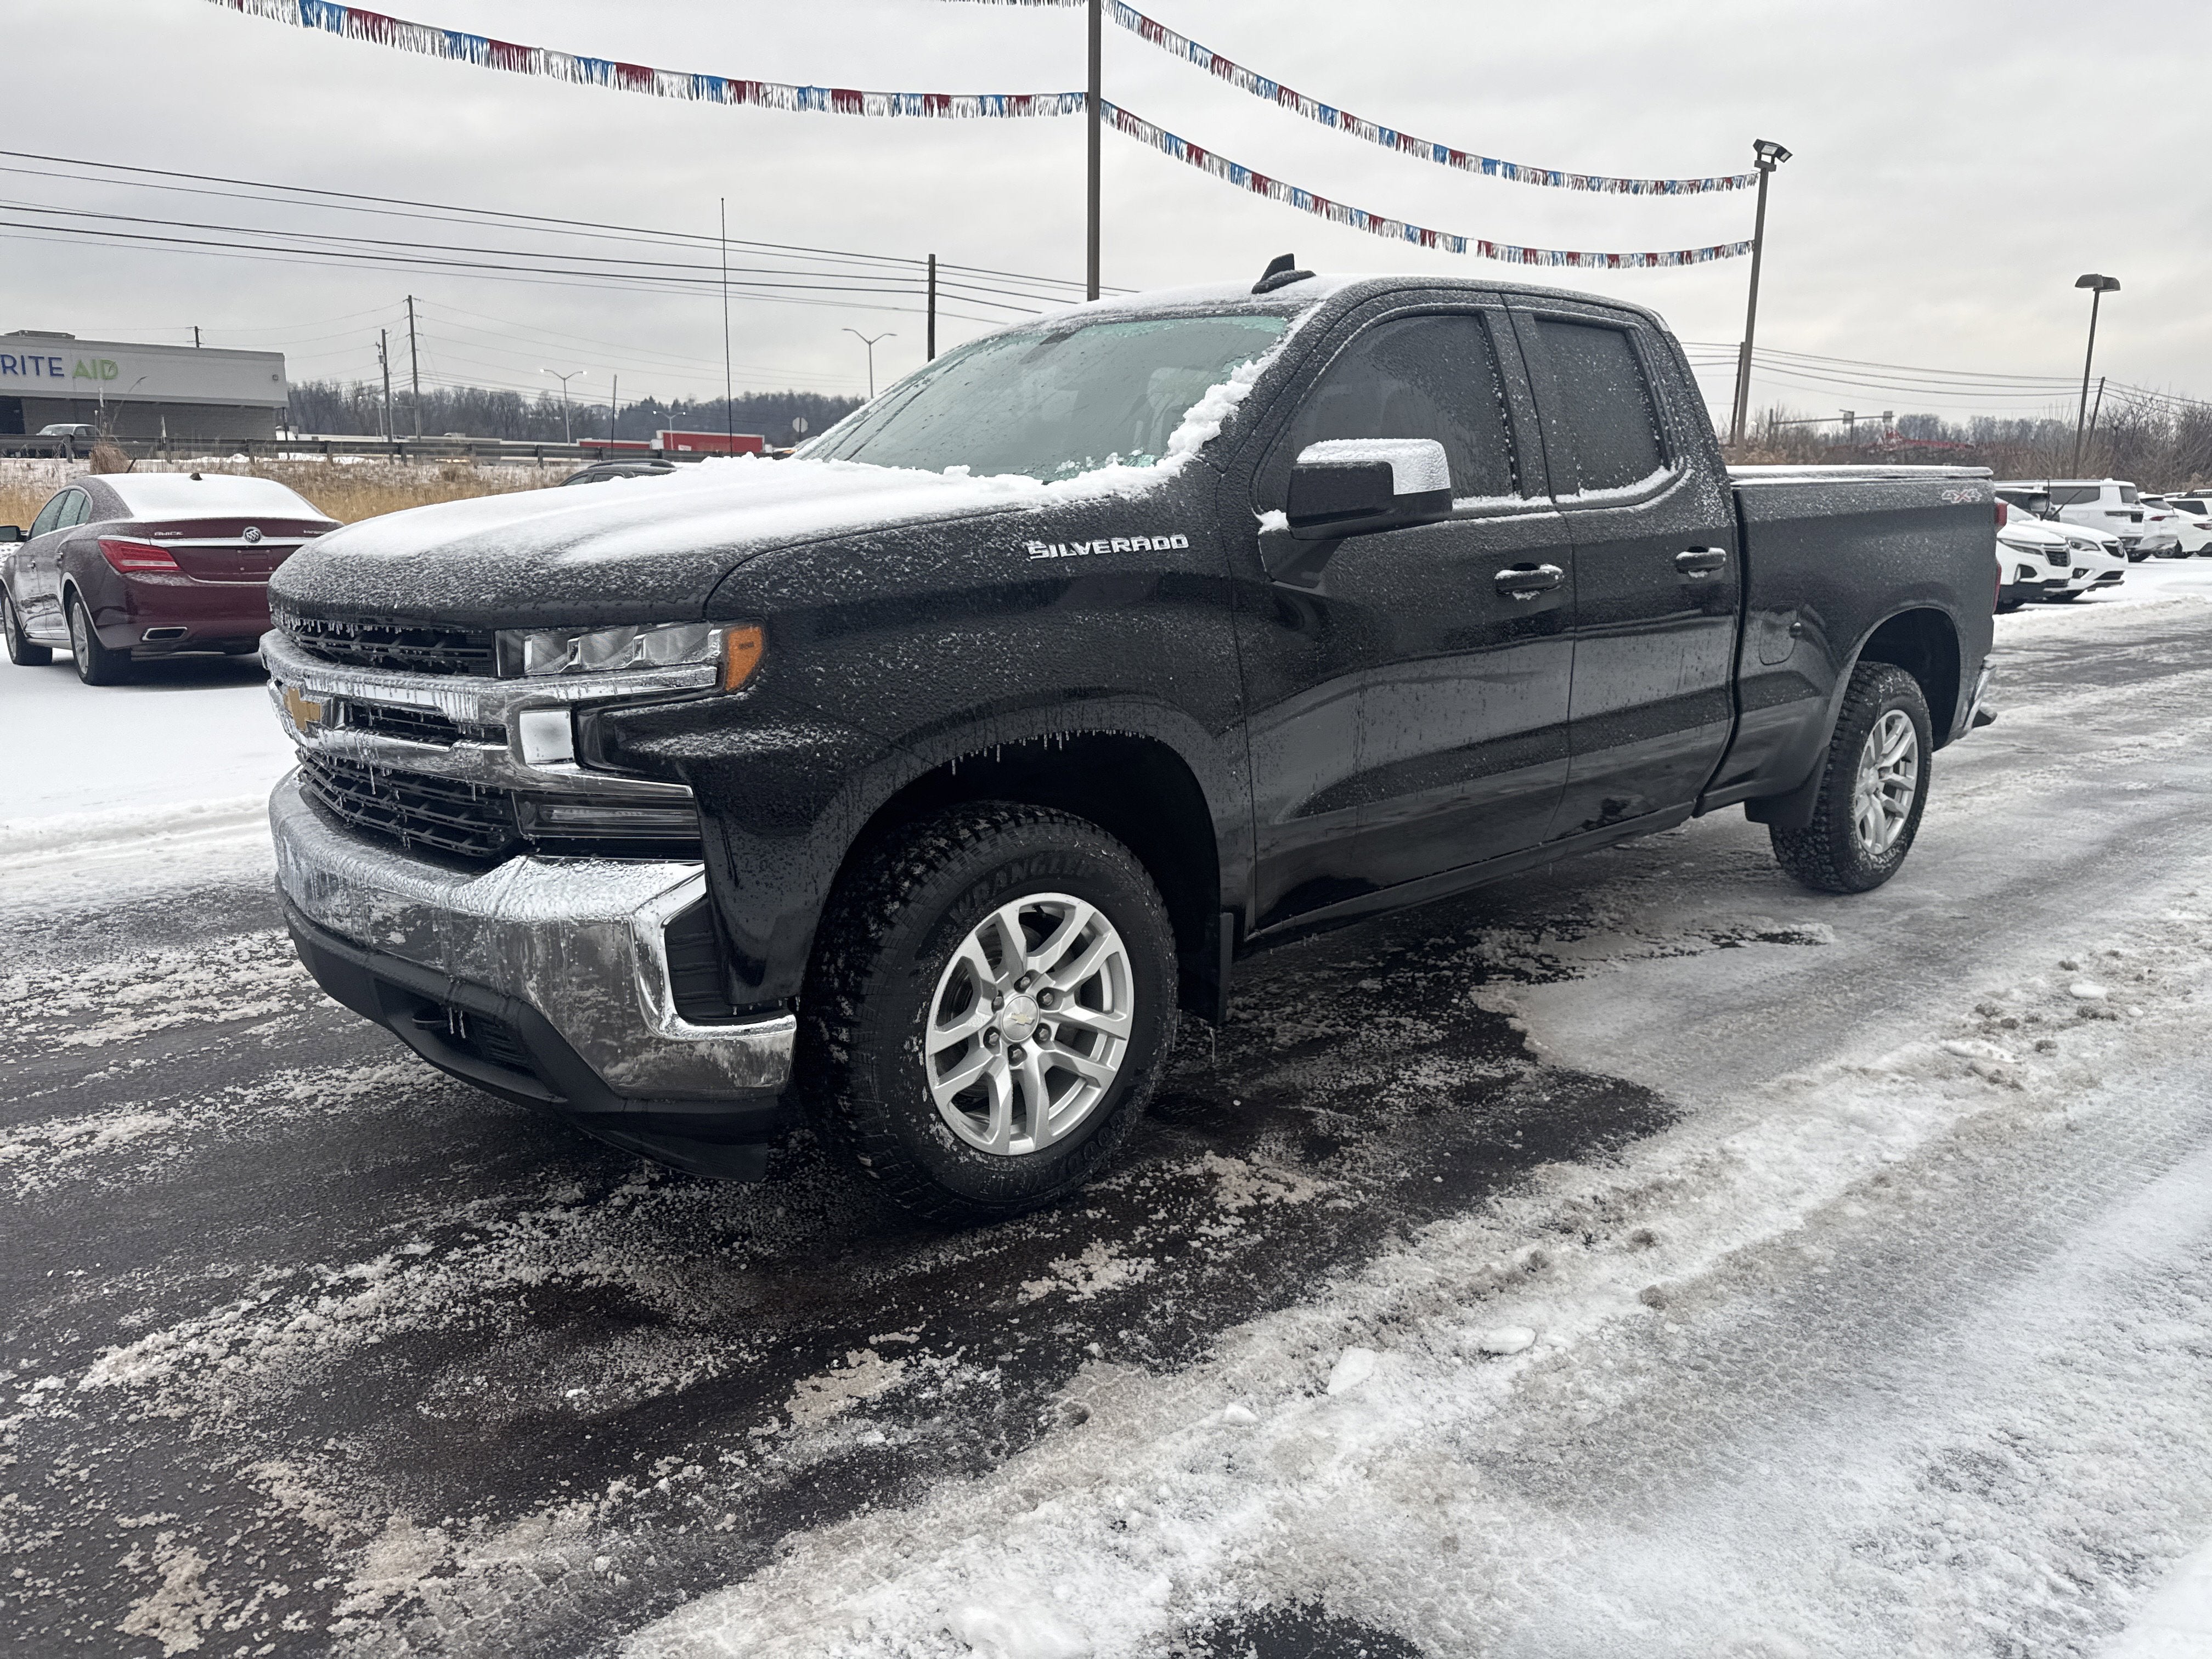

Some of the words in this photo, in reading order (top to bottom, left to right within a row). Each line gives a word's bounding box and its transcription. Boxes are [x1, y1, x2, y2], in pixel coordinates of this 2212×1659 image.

[0, 354, 65, 377] RITE
[72, 359, 119, 380] AID
[1028, 535, 1189, 560] SILVERADO
